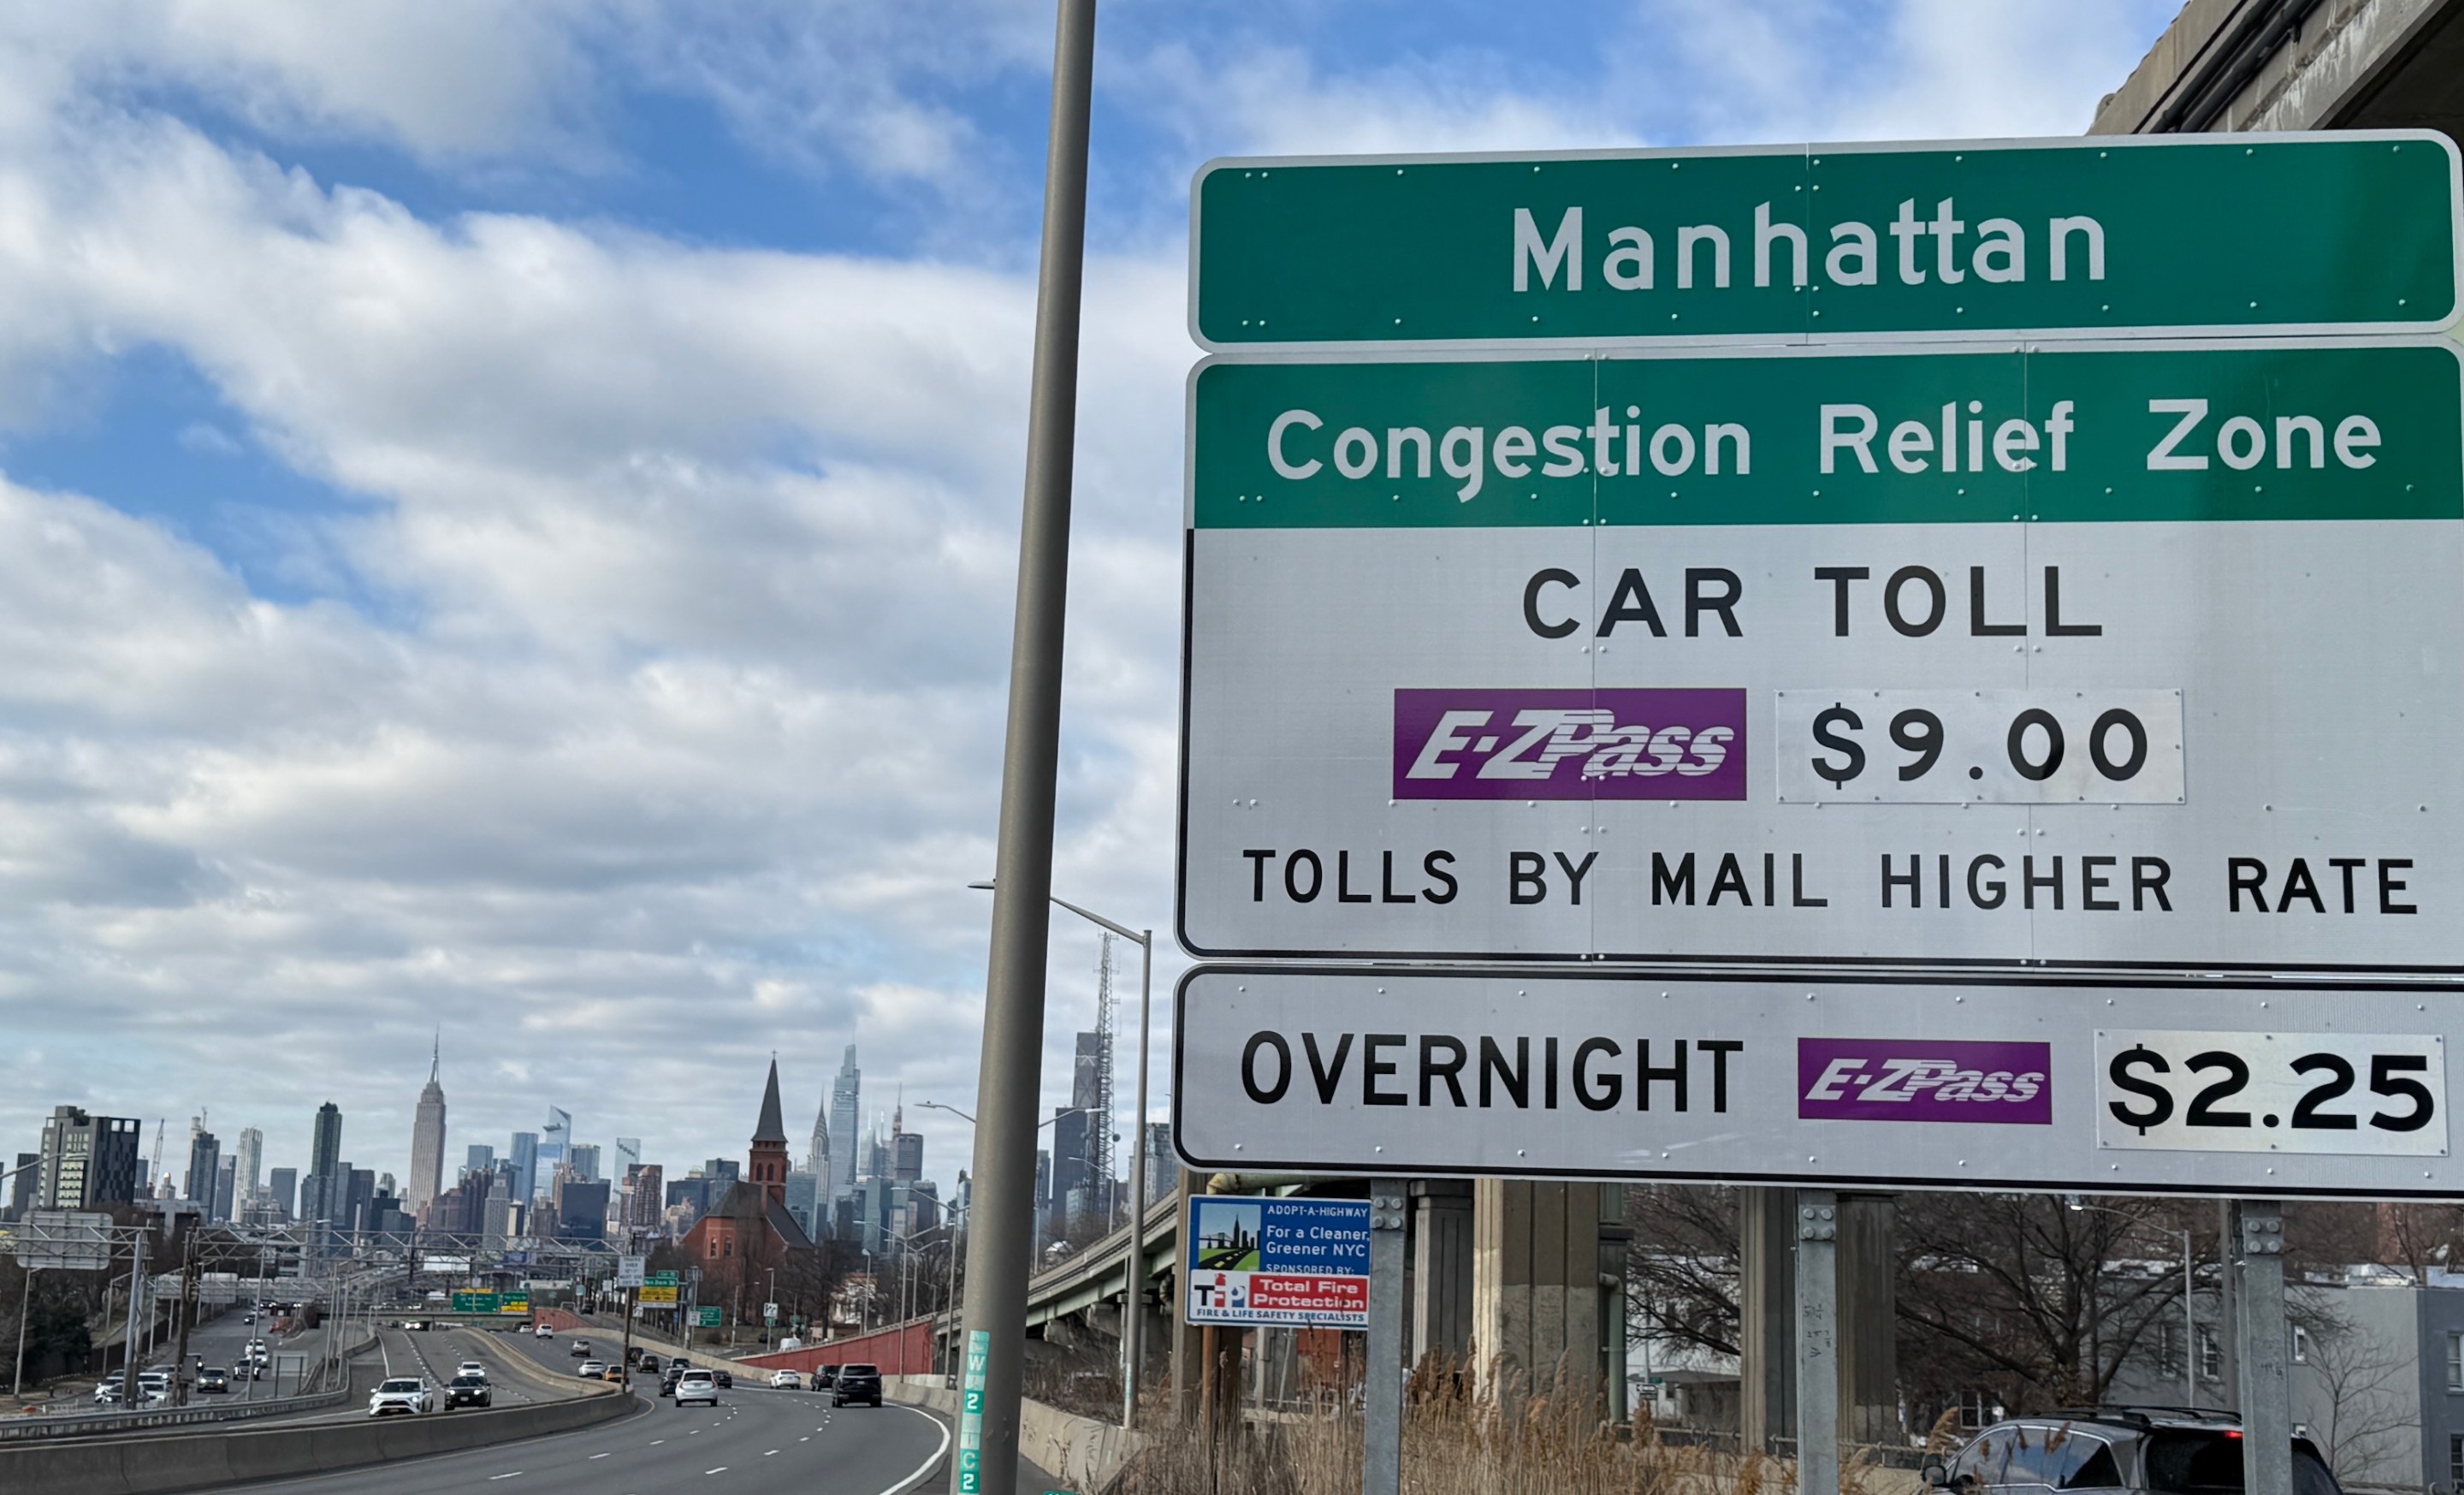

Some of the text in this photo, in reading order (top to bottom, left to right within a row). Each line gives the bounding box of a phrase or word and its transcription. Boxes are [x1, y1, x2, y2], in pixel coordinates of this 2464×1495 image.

[1513, 197, 2106, 292] Manhattan
[1267, 399, 2382, 503] Congestion Relief Zone
[1524, 566, 2102, 639] CAR TOLL
[1405, 703, 2147, 791] E-ZPass $9.00
[1243, 848, 2418, 915] TOLLS BY MAIL HIGHER RATE
[1241, 1030, 2434, 1136] OVERNIGHT E-ZPass $2.25
[1267, 1205, 1368, 1217] ADOPT-A-HIGHWAY
[1266, 1225, 1291, 1238] For
[1295, 1228, 1305, 1238] a
[1266, 1241, 1365, 1257] Greener NYC
[1265, 1263, 1333, 1274] SPONSORED
[1259, 1279, 1358, 1293] Total Fire
[1253, 1293, 1364, 1308] Protection
[1197, 1308, 1219, 1317] FIRE
[1232, 1309, 1253, 1318] LIFE
[1256, 1310, 1295, 1320] SAFETY
[1297, 1311, 1365, 1322] SPECIALISTS
